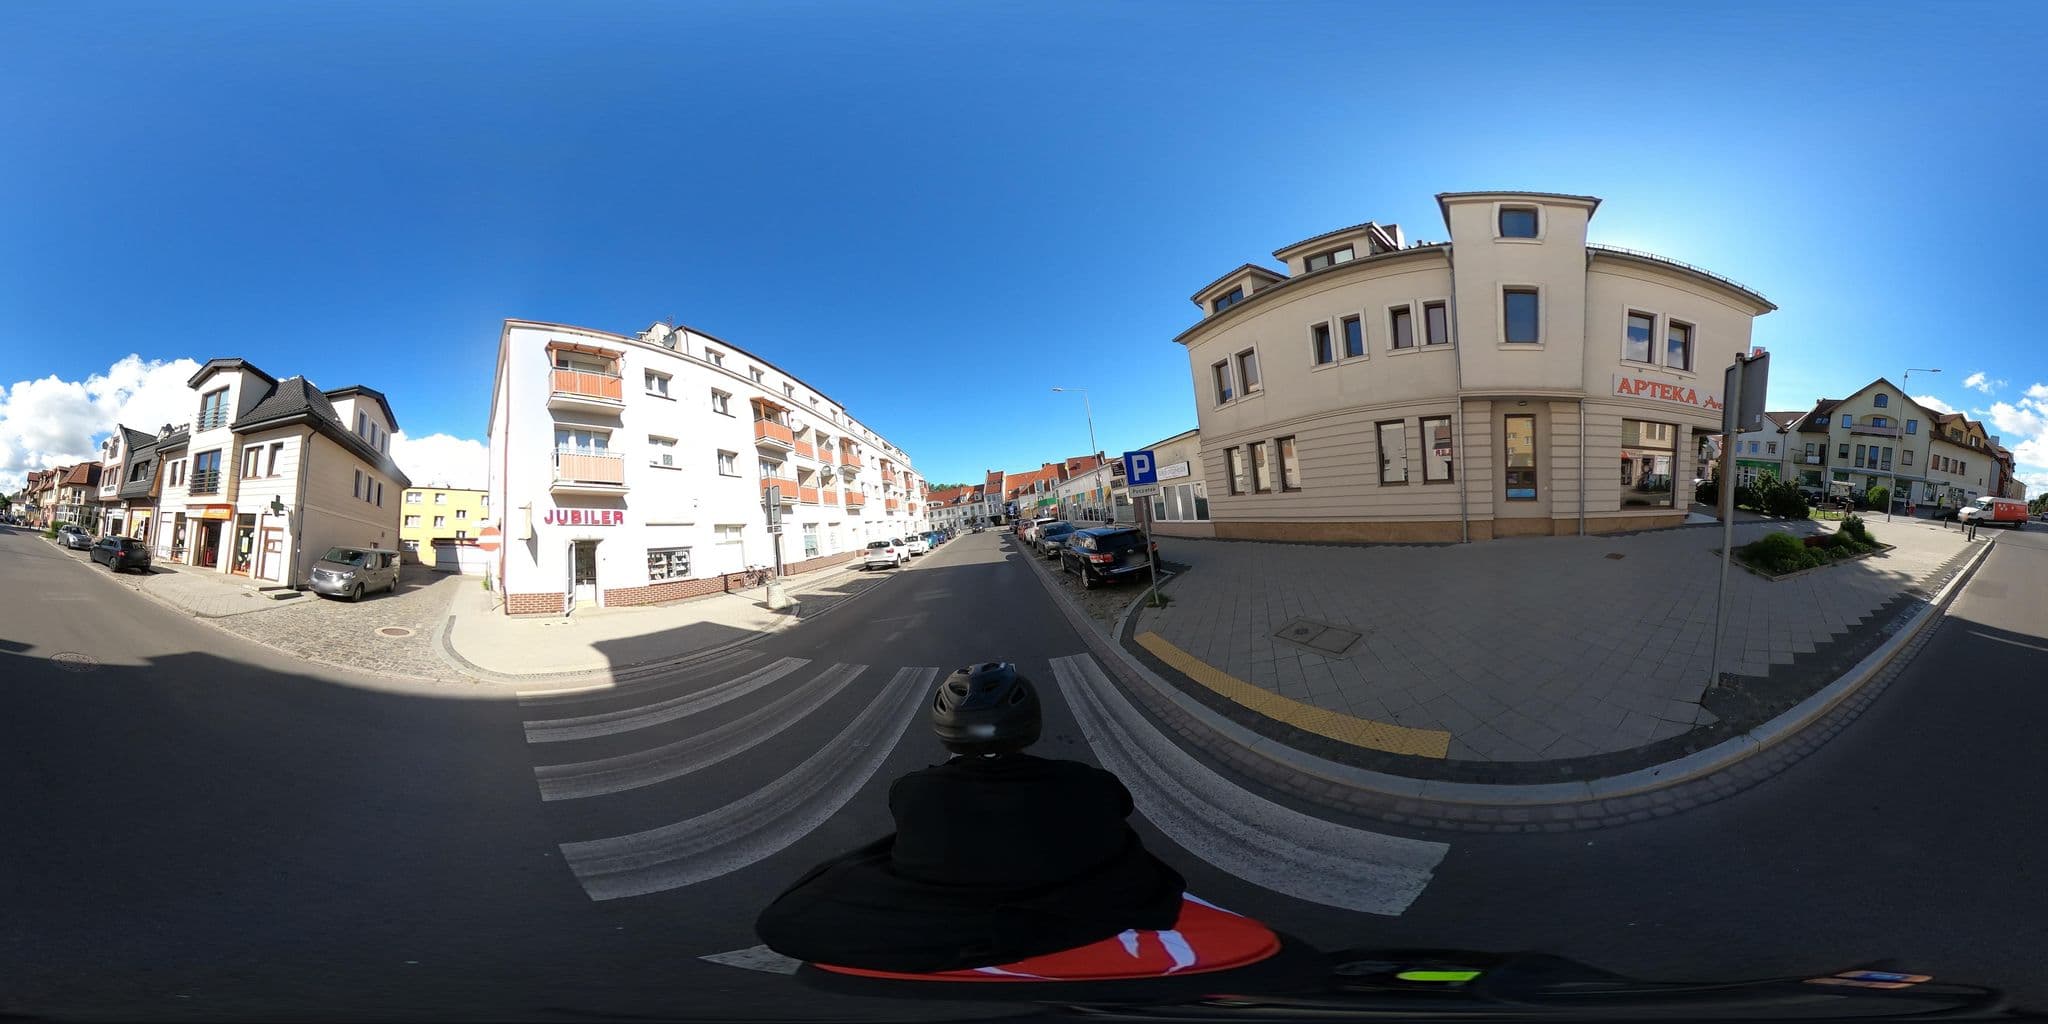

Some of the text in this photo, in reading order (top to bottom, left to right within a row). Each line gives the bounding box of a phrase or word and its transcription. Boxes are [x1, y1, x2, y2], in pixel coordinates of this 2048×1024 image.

[1617, 377, 1698, 405] APTEKA
[1131, 455, 1150, 481] P
[544, 509, 624, 525] JUBILER
